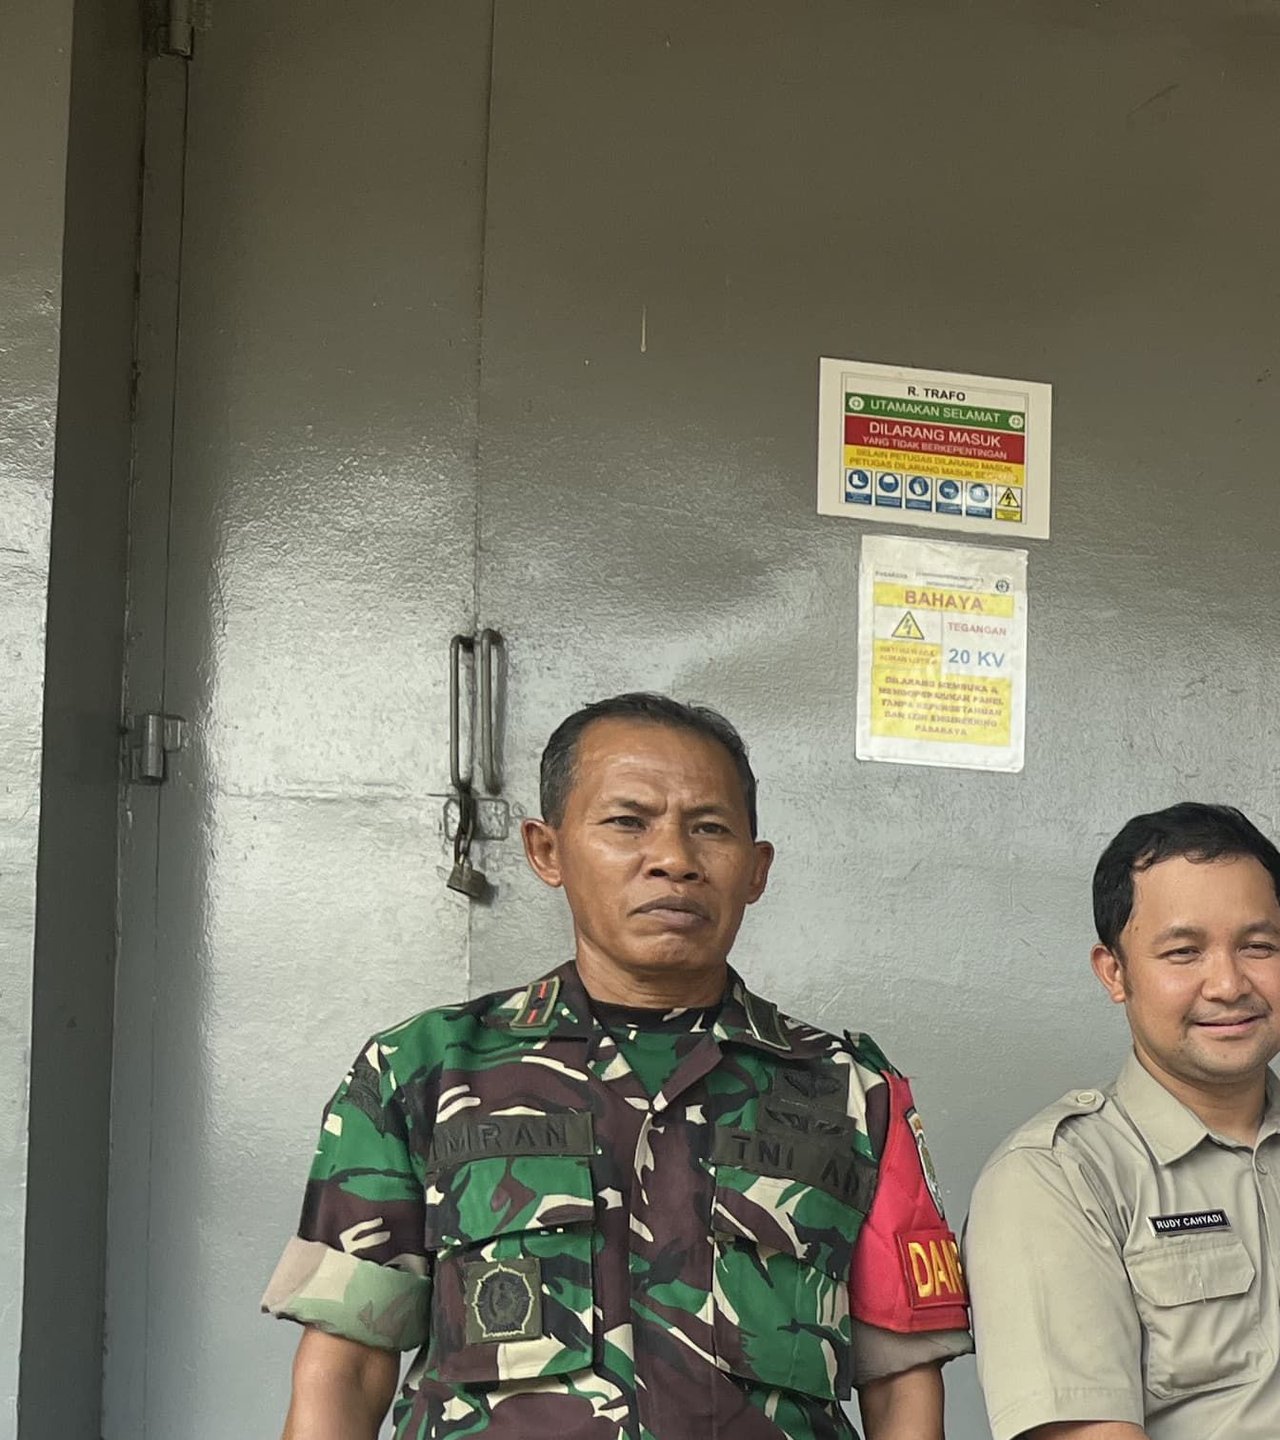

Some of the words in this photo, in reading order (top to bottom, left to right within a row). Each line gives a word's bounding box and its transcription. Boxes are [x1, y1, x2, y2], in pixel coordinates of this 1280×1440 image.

[907, 386, 919, 397] R.
[924, 388, 966, 402] TRAFO
[870, 400, 940, 417] UTAMAKAN
[943, 408, 1000, 423] SELAMAT
[862, 436, 889, 447] YANG
[892, 439, 921, 450] TIDAK
[869, 422, 945, 441] DILARANG
[948, 430, 1002, 448] MASUK
[904, 589, 984, 611] BAHAYA
[948, 621, 1007, 636] TEGANGAN
[948, 648, 971, 664] 20
[977, 651, 1006, 668] KV
[731, 1135, 795, 1171] TNI
[1156, 1218, 1182, 1230] RUDY
[1183, 1214, 1223, 1227] CAHYADI
